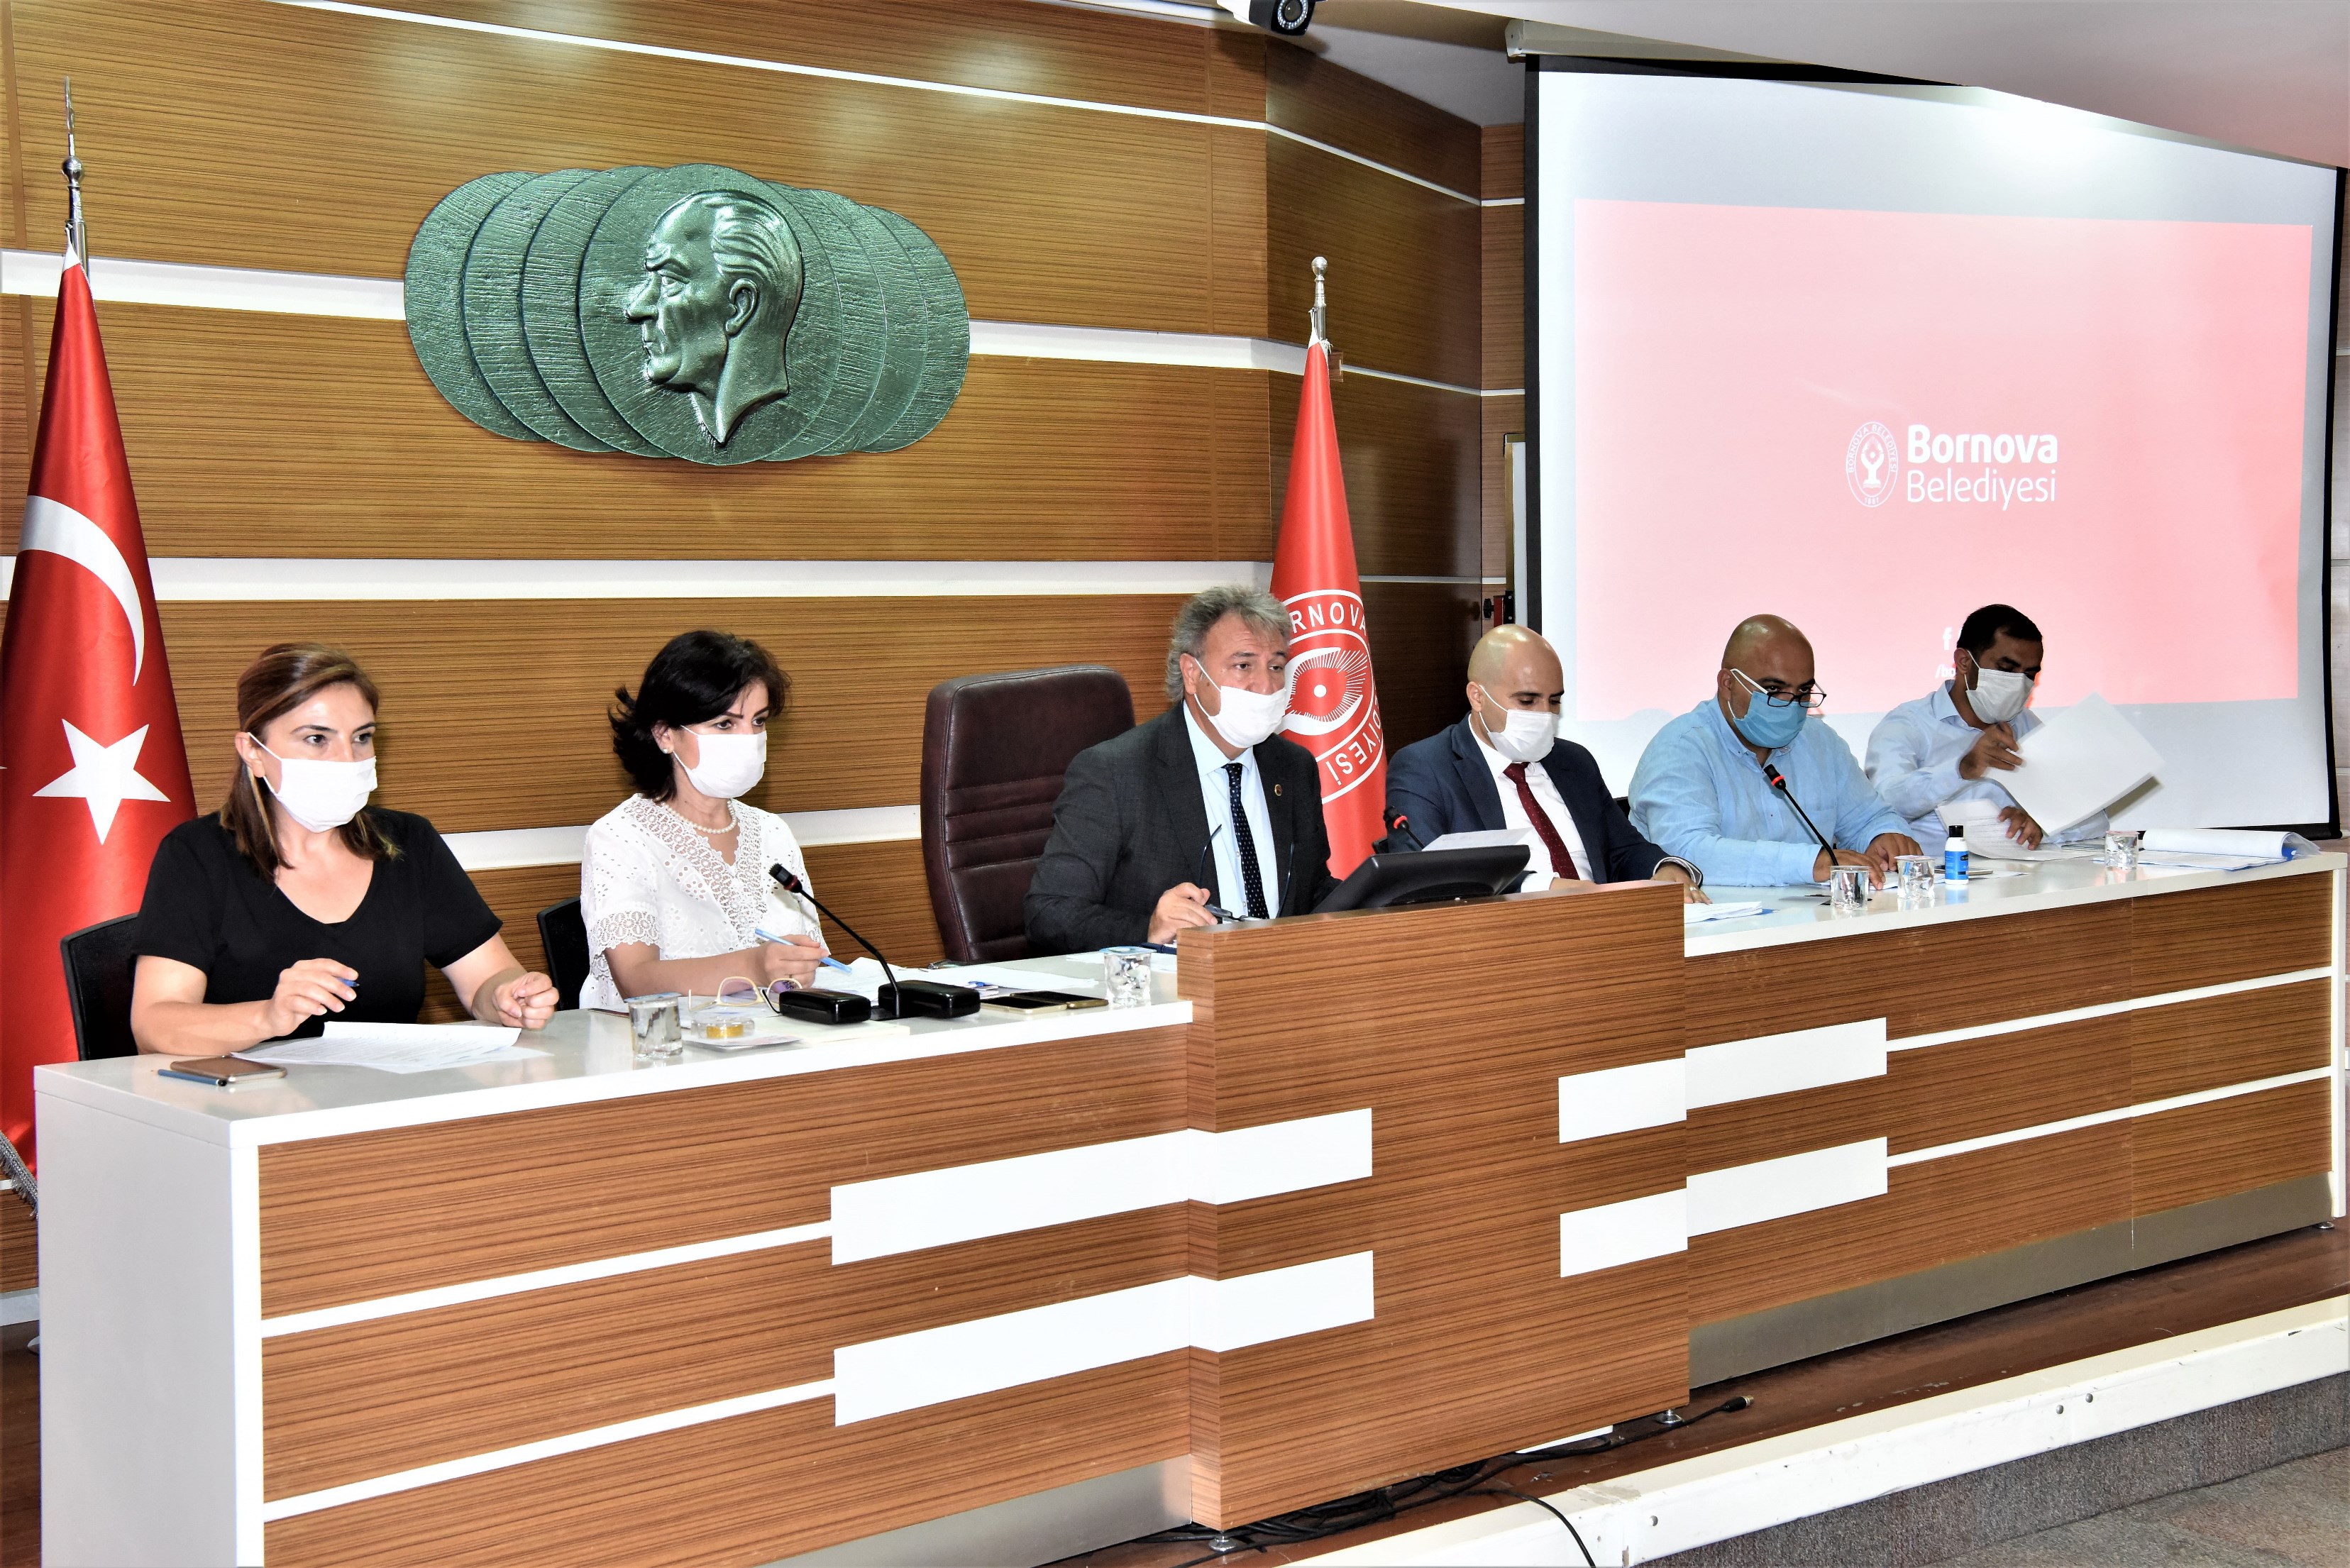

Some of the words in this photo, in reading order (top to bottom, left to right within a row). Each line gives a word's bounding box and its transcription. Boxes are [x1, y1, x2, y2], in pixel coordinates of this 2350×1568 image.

[1848, 426, 1869, 473] BORNOVA
[1908, 424, 2058, 464] Bornova
[1907, 468, 2056, 511] Belediyesi
[1289, 602, 1367, 636] RNOVA
[1325, 694, 1381, 785] DİYESİ
